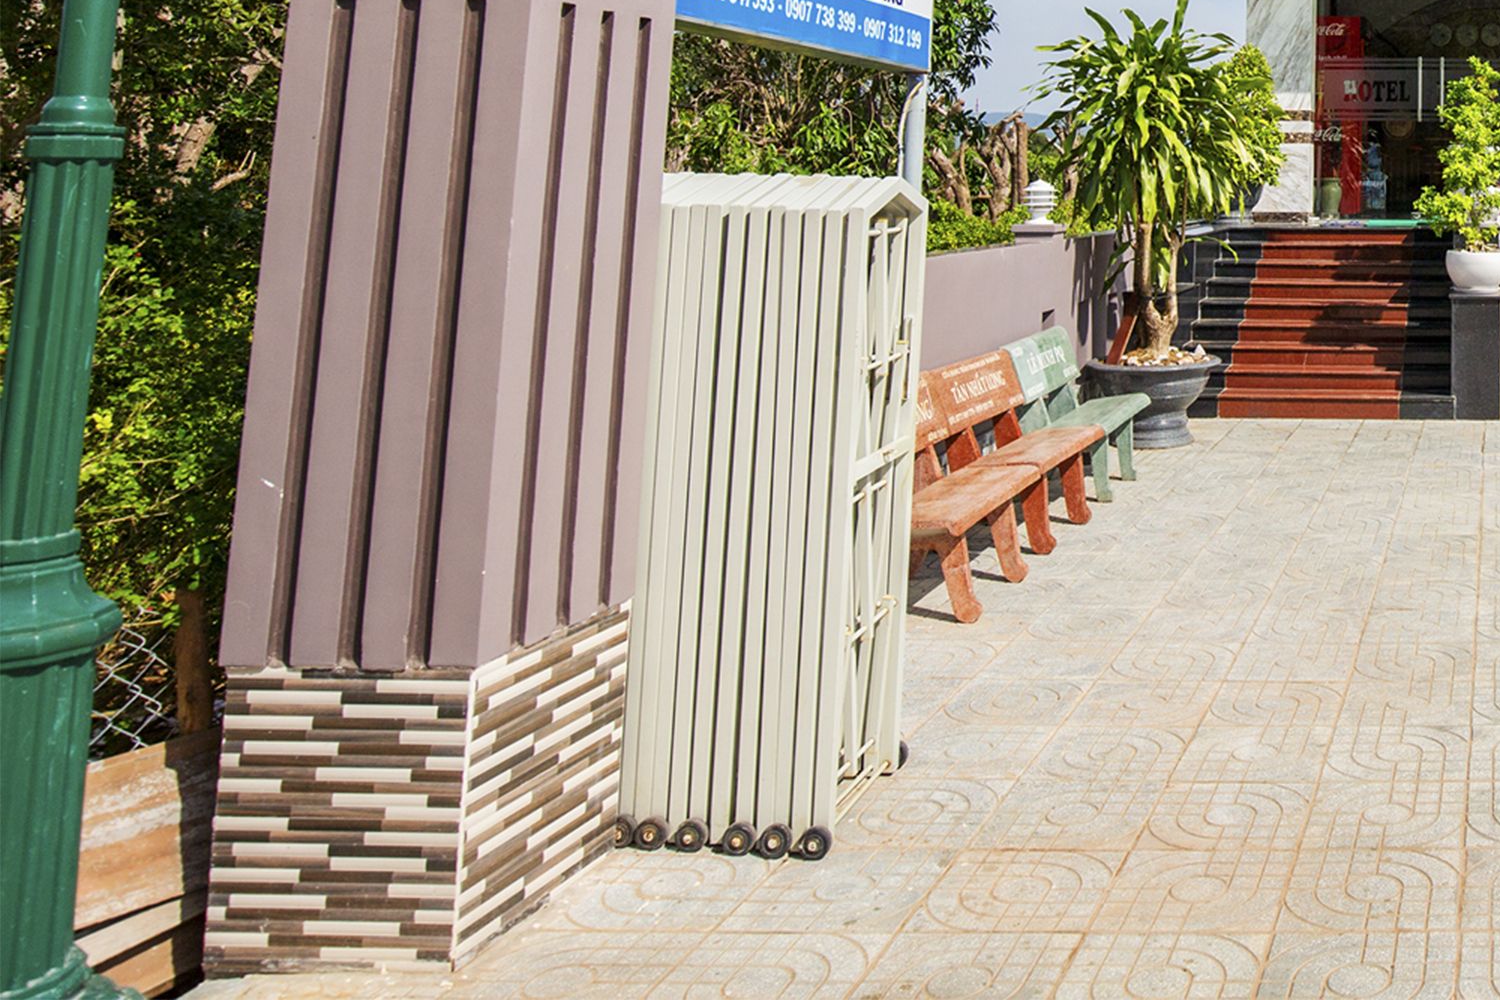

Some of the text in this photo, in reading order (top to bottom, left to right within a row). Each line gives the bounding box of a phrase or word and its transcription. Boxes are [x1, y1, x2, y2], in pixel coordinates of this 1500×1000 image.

[815, 4, 836, 27] 738
[837, 10, 856, 33] 399
[863, 17, 886, 41] 0907
[888, 24, 905, 45] 312
[906, 28, 922, 50] 199
